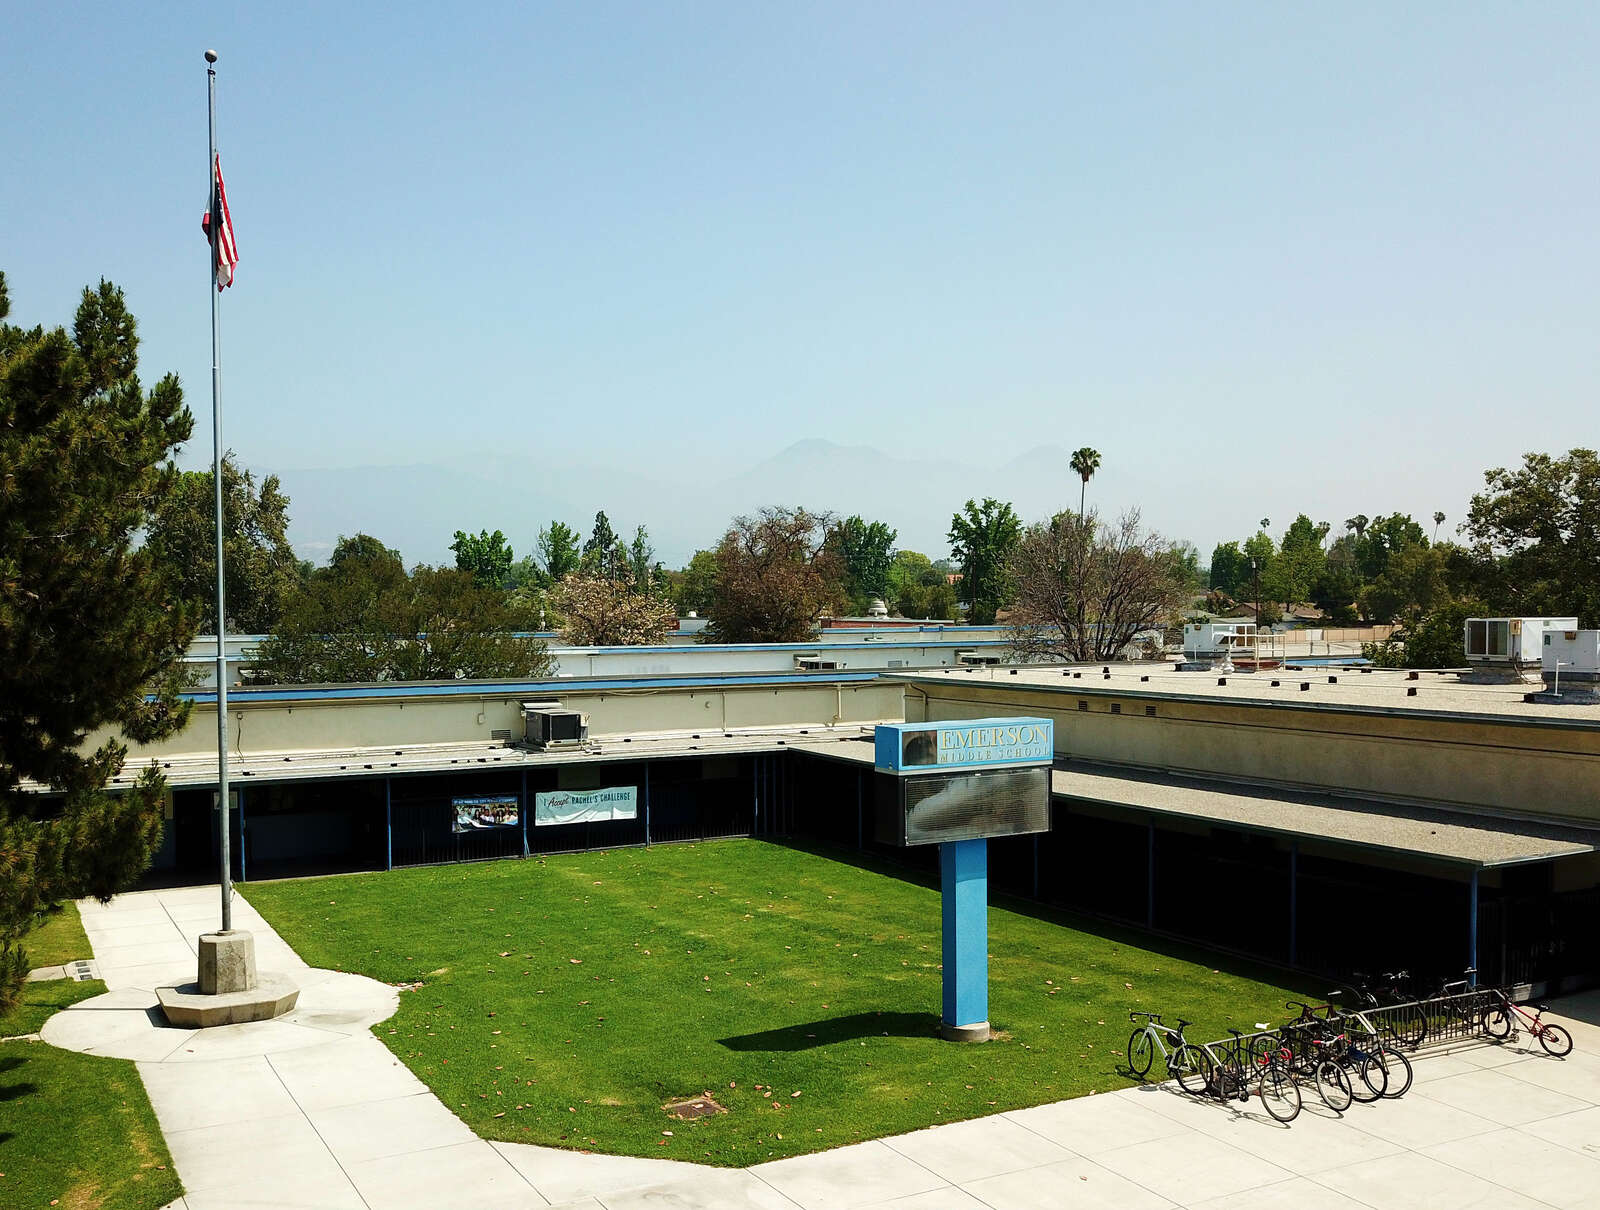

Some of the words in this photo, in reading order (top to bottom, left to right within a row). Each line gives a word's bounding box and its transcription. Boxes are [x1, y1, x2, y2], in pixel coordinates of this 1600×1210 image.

[940, 725, 1050, 750] EMERSON
[940, 750, 992, 763] MIDDLE
[999, 746, 1050, 759] SCHOOL
[548, 795, 569, 807] Accept
[571, 795, 598, 805] RACHEL'S
[600, 792, 631, 802] CHALLENGE
